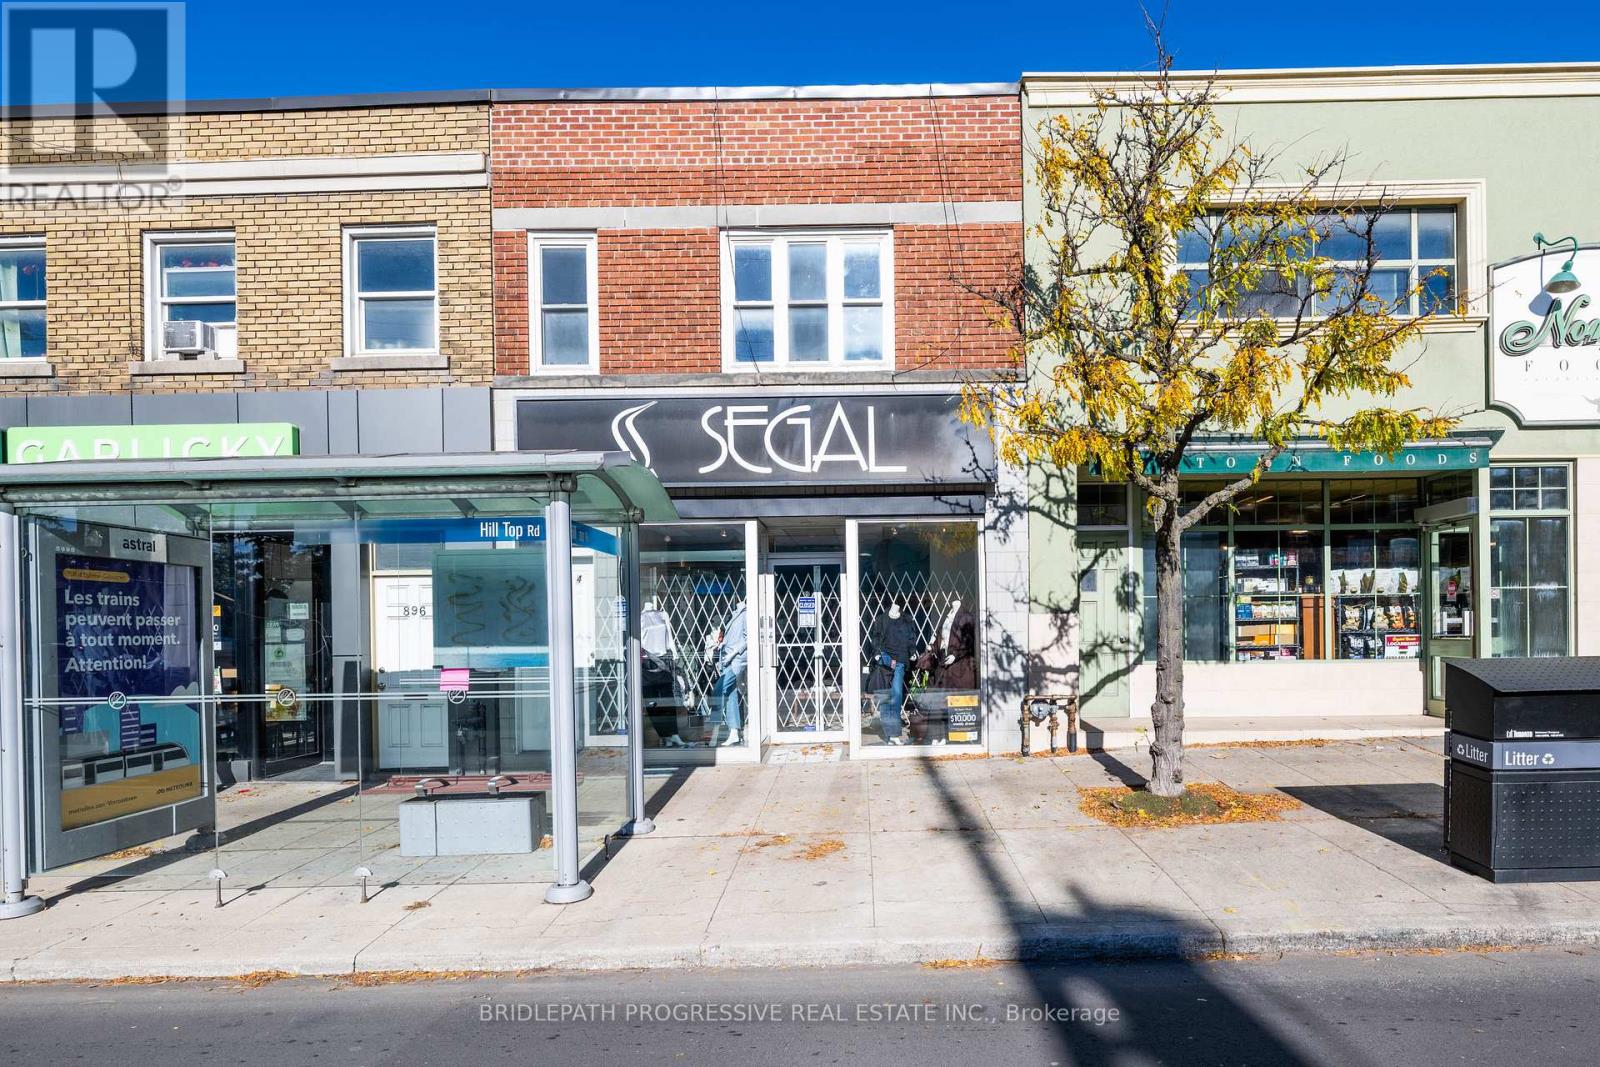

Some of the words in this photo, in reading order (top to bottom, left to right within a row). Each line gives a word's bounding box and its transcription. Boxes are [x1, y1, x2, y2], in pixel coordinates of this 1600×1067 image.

[699, 401, 908, 473] SEGAL
[1343, 452, 1477, 466] FOODS
[480, 522, 498, 537] Hill
[502, 521, 523, 539] Top
[527, 524, 540, 537] Rd
[122, 538, 156, 552] astral
[64, 587, 93, 605] Les
[98, 591, 140, 607] trains
[403, 604, 427, 617] 896
[65, 613, 134, 630] peuvent
[135, 616, 181, 630] passer
[65, 631, 75, 647] à
[80, 633, 114, 647] tout
[118, 633, 181, 646] moment.
[64, 655, 147, 673] Attention!
[1466, 743, 1488, 763] Litter
[1505, 751, 1539, 766] Litter
